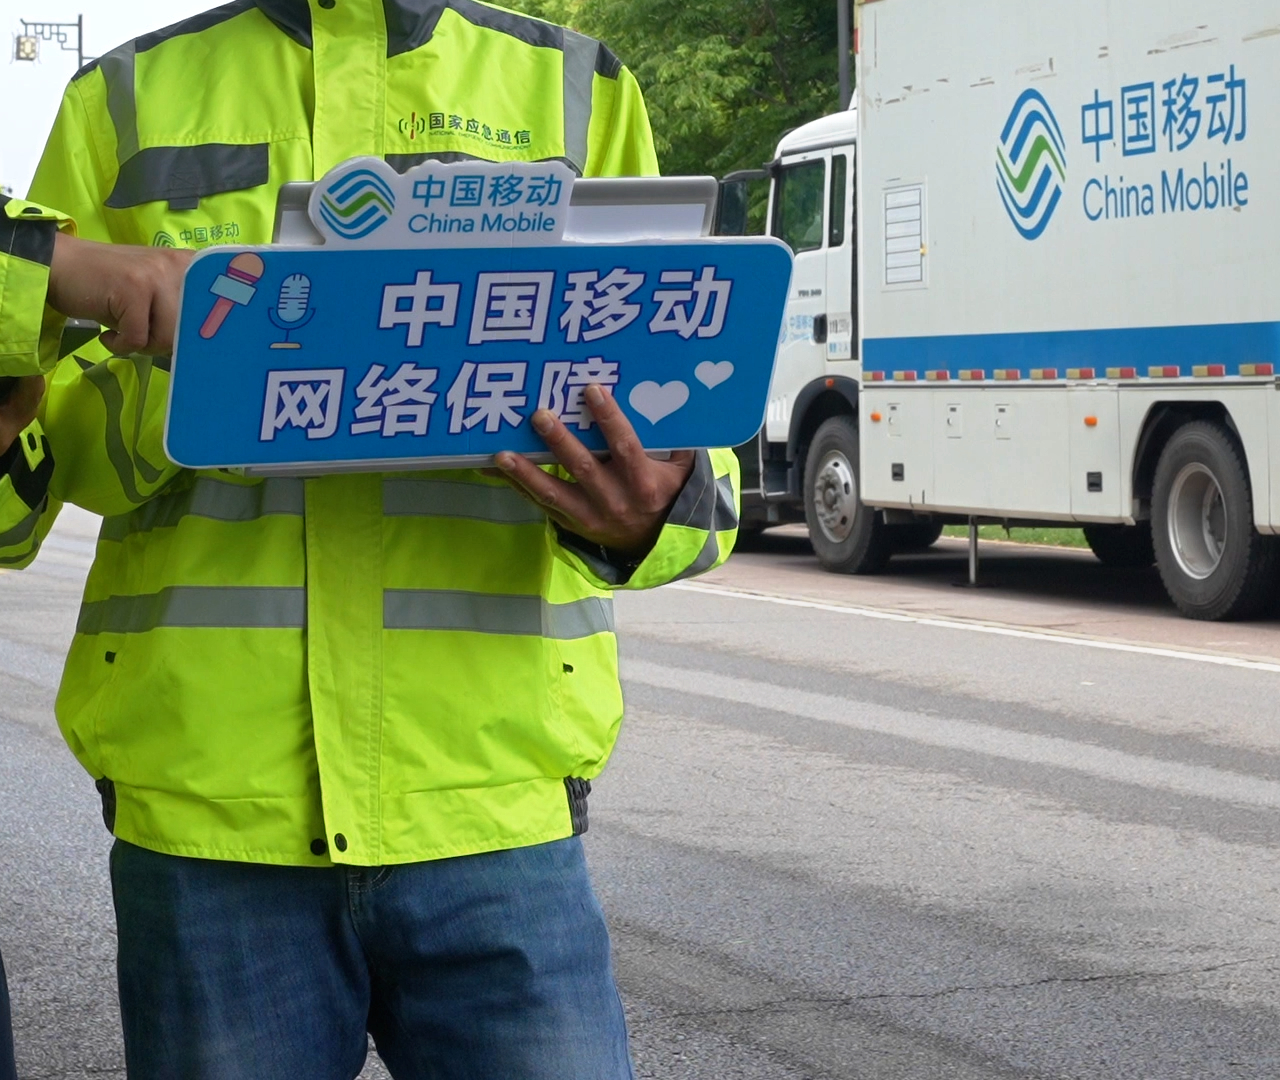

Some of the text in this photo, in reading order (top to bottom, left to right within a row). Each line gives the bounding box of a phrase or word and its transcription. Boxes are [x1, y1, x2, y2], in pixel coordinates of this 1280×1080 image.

[429, 112, 531, 145] 国家应急通信
[1081, 64, 1247, 163] 中国移动
[411, 172, 561, 209] 中国移动
[1083, 158, 1248, 221] China Mobile
[179, 221, 240, 244] 中国移动
[408, 210, 556, 235] China Mobile
[380, 266, 732, 347] 中国移动
[260, 356, 619, 441] 网络保障
